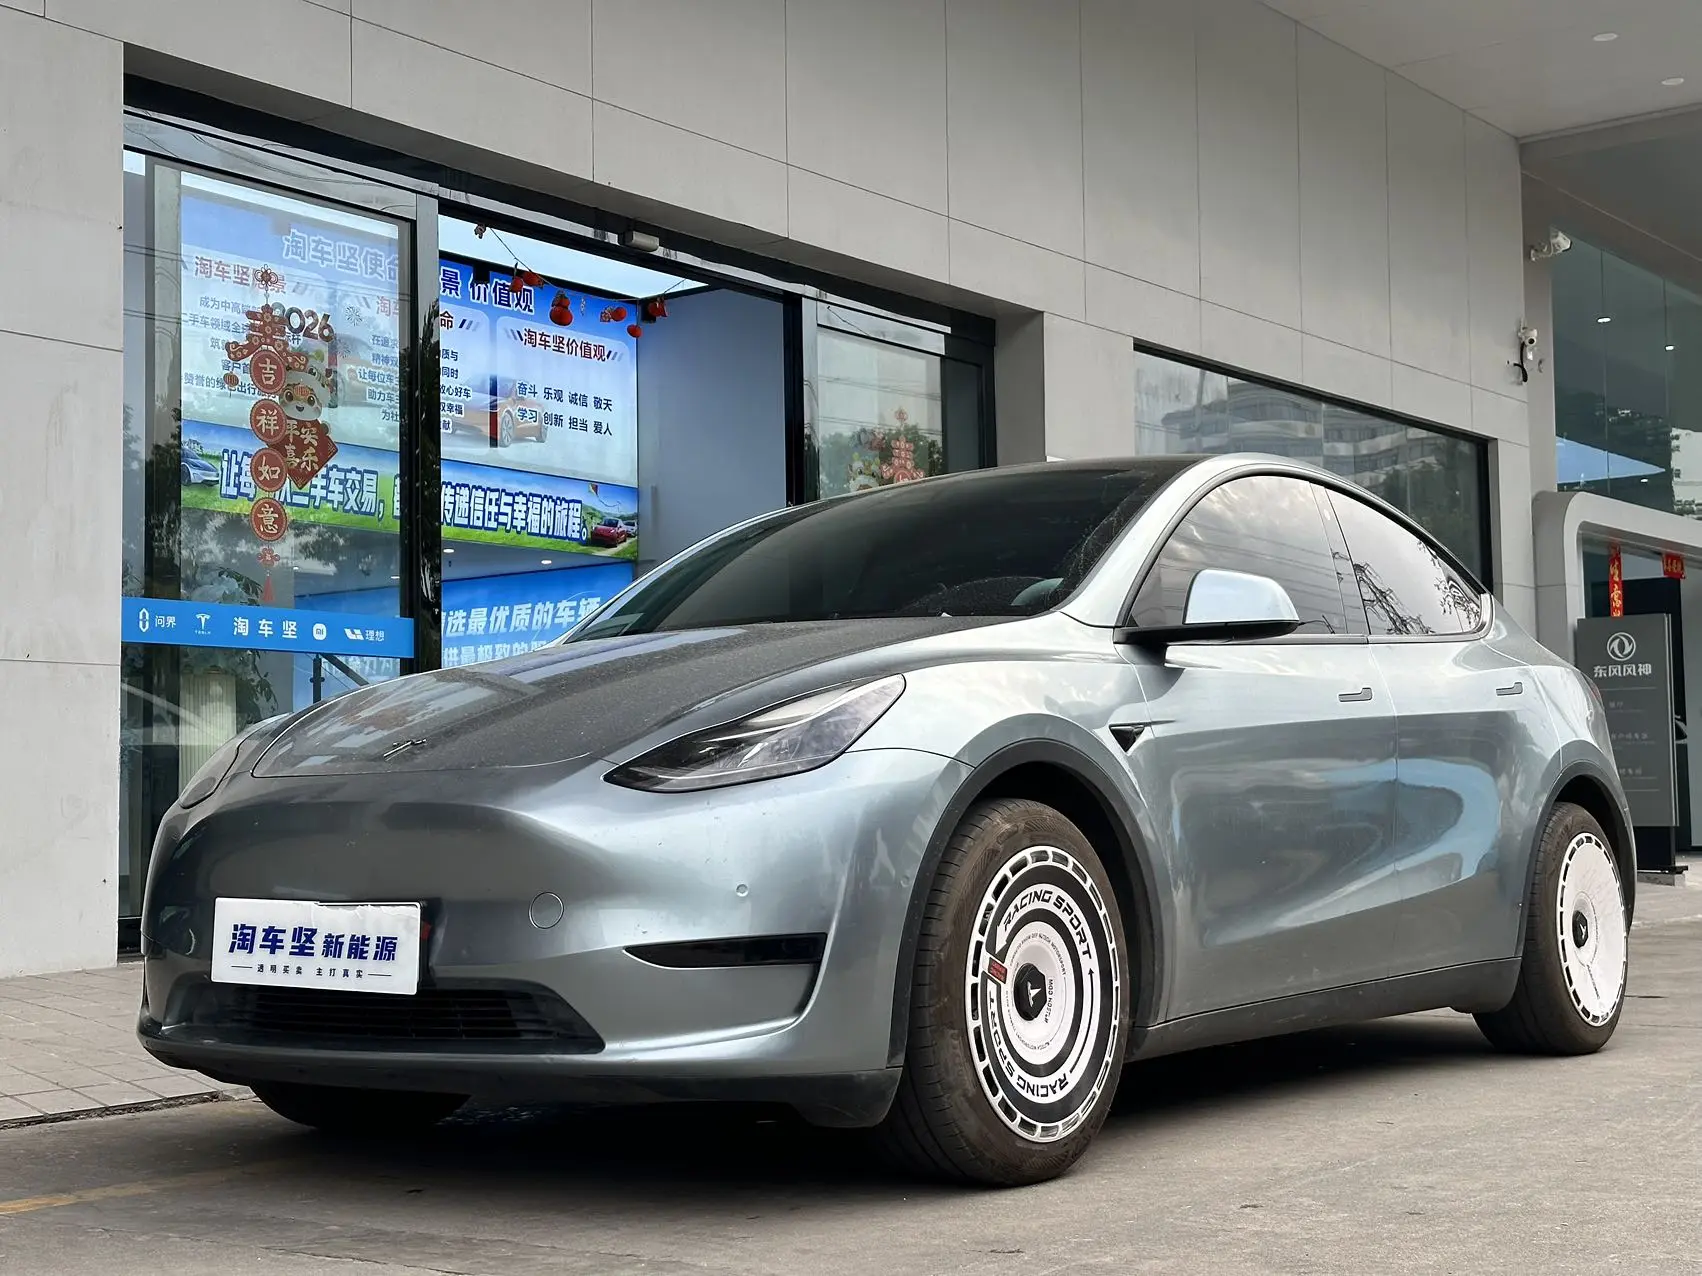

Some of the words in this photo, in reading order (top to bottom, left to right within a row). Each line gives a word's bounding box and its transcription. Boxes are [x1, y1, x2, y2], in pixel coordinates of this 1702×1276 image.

[440, 348, 459, 362] 质与
[523, 328, 607, 362] 淘车坚价值观
[440, 366, 459, 380] 同时
[517, 382, 538, 398] 奋斗
[543, 387, 564, 403] 乐观
[568, 391, 588, 408] 诚信
[593, 396, 613, 412] 敬天
[517, 406, 538, 423] 学习
[543, 411, 564, 428] 创新
[568, 415, 588, 432] 担当
[593, 420, 613, 436] 爱人
[155, 615, 176, 628] 问界
[233, 617, 298, 639] 淘车坚
[441, 597, 601, 637] 选最优质的车辆
[365, 629, 385, 642] 理想
[1593, 664, 1652, 677] 东风风神
[1003, 889, 1053, 932] RACING
[1052, 894, 1093, 960] SPORT
[257, 963, 303, 975] 透明买卖
[316, 967, 363, 979] 主打真实
[988, 989, 1016, 1075] SPORT
[1016, 1072, 1070, 1098] RACING
